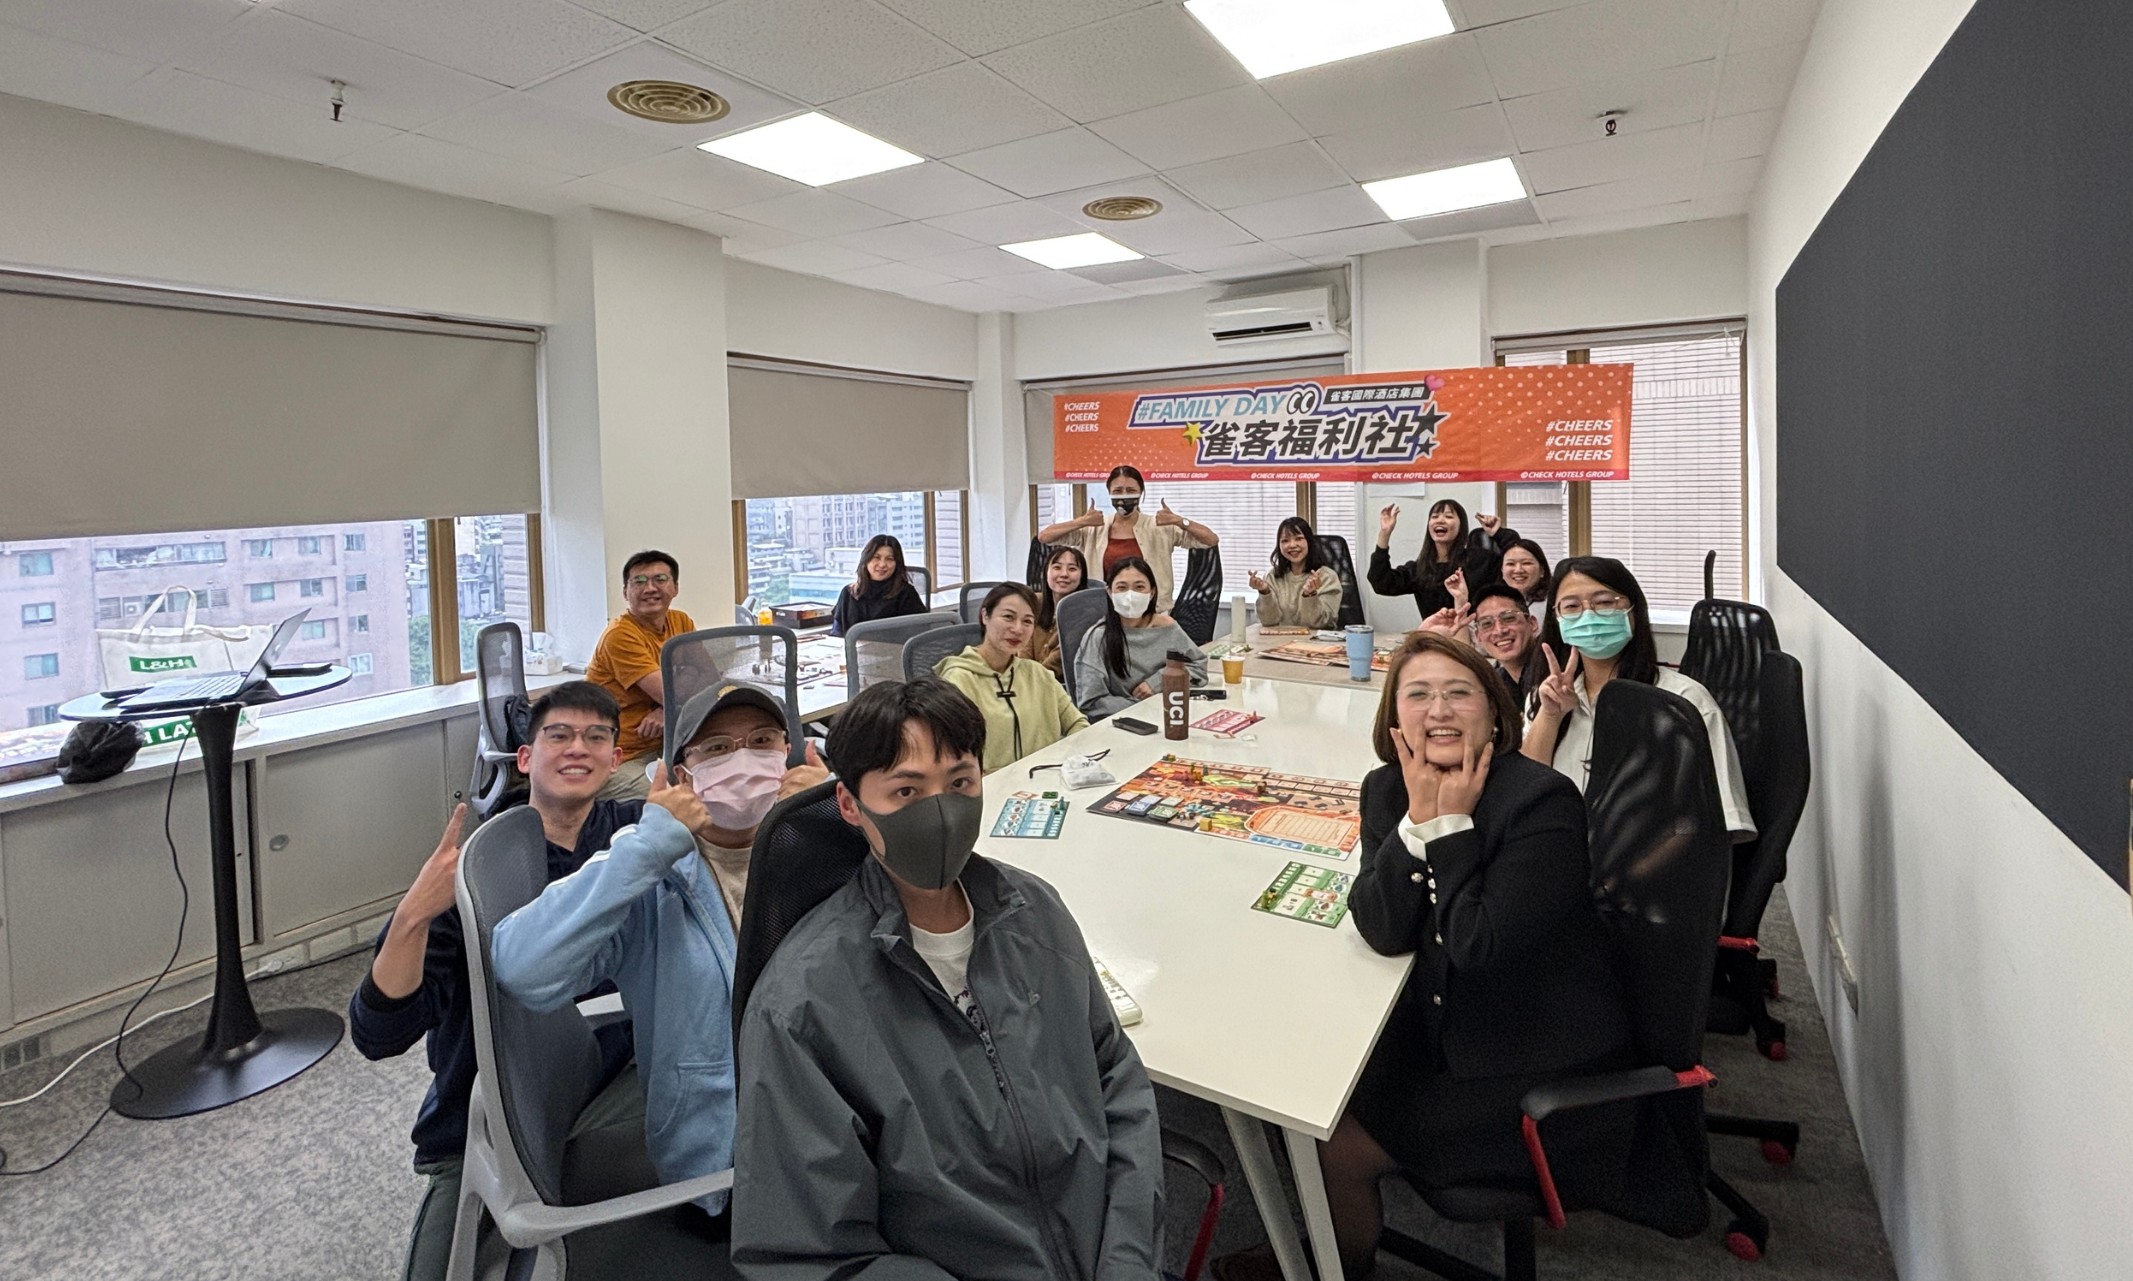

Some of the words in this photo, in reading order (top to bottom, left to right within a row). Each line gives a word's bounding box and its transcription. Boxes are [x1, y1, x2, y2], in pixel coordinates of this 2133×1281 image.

[1331, 386, 1425, 401] 雀客國際酒店集團
[1064, 402, 1100, 411] #CHEERS
[1138, 398, 1229, 420] #FAMILY
[1234, 395, 1287, 416] DAY
[1065, 413, 1099, 422] #CHEERS
[1065, 424, 1099, 433] #CHEERS
[1546, 420, 1613, 432] #CHEERS
[1204, 414, 1414, 457] 雀客福利社
[1545, 434, 1613, 447] #CHEERS
[1545, 449, 1613, 461] #CHEERS
[1169, 691, 1184, 725] UCI
